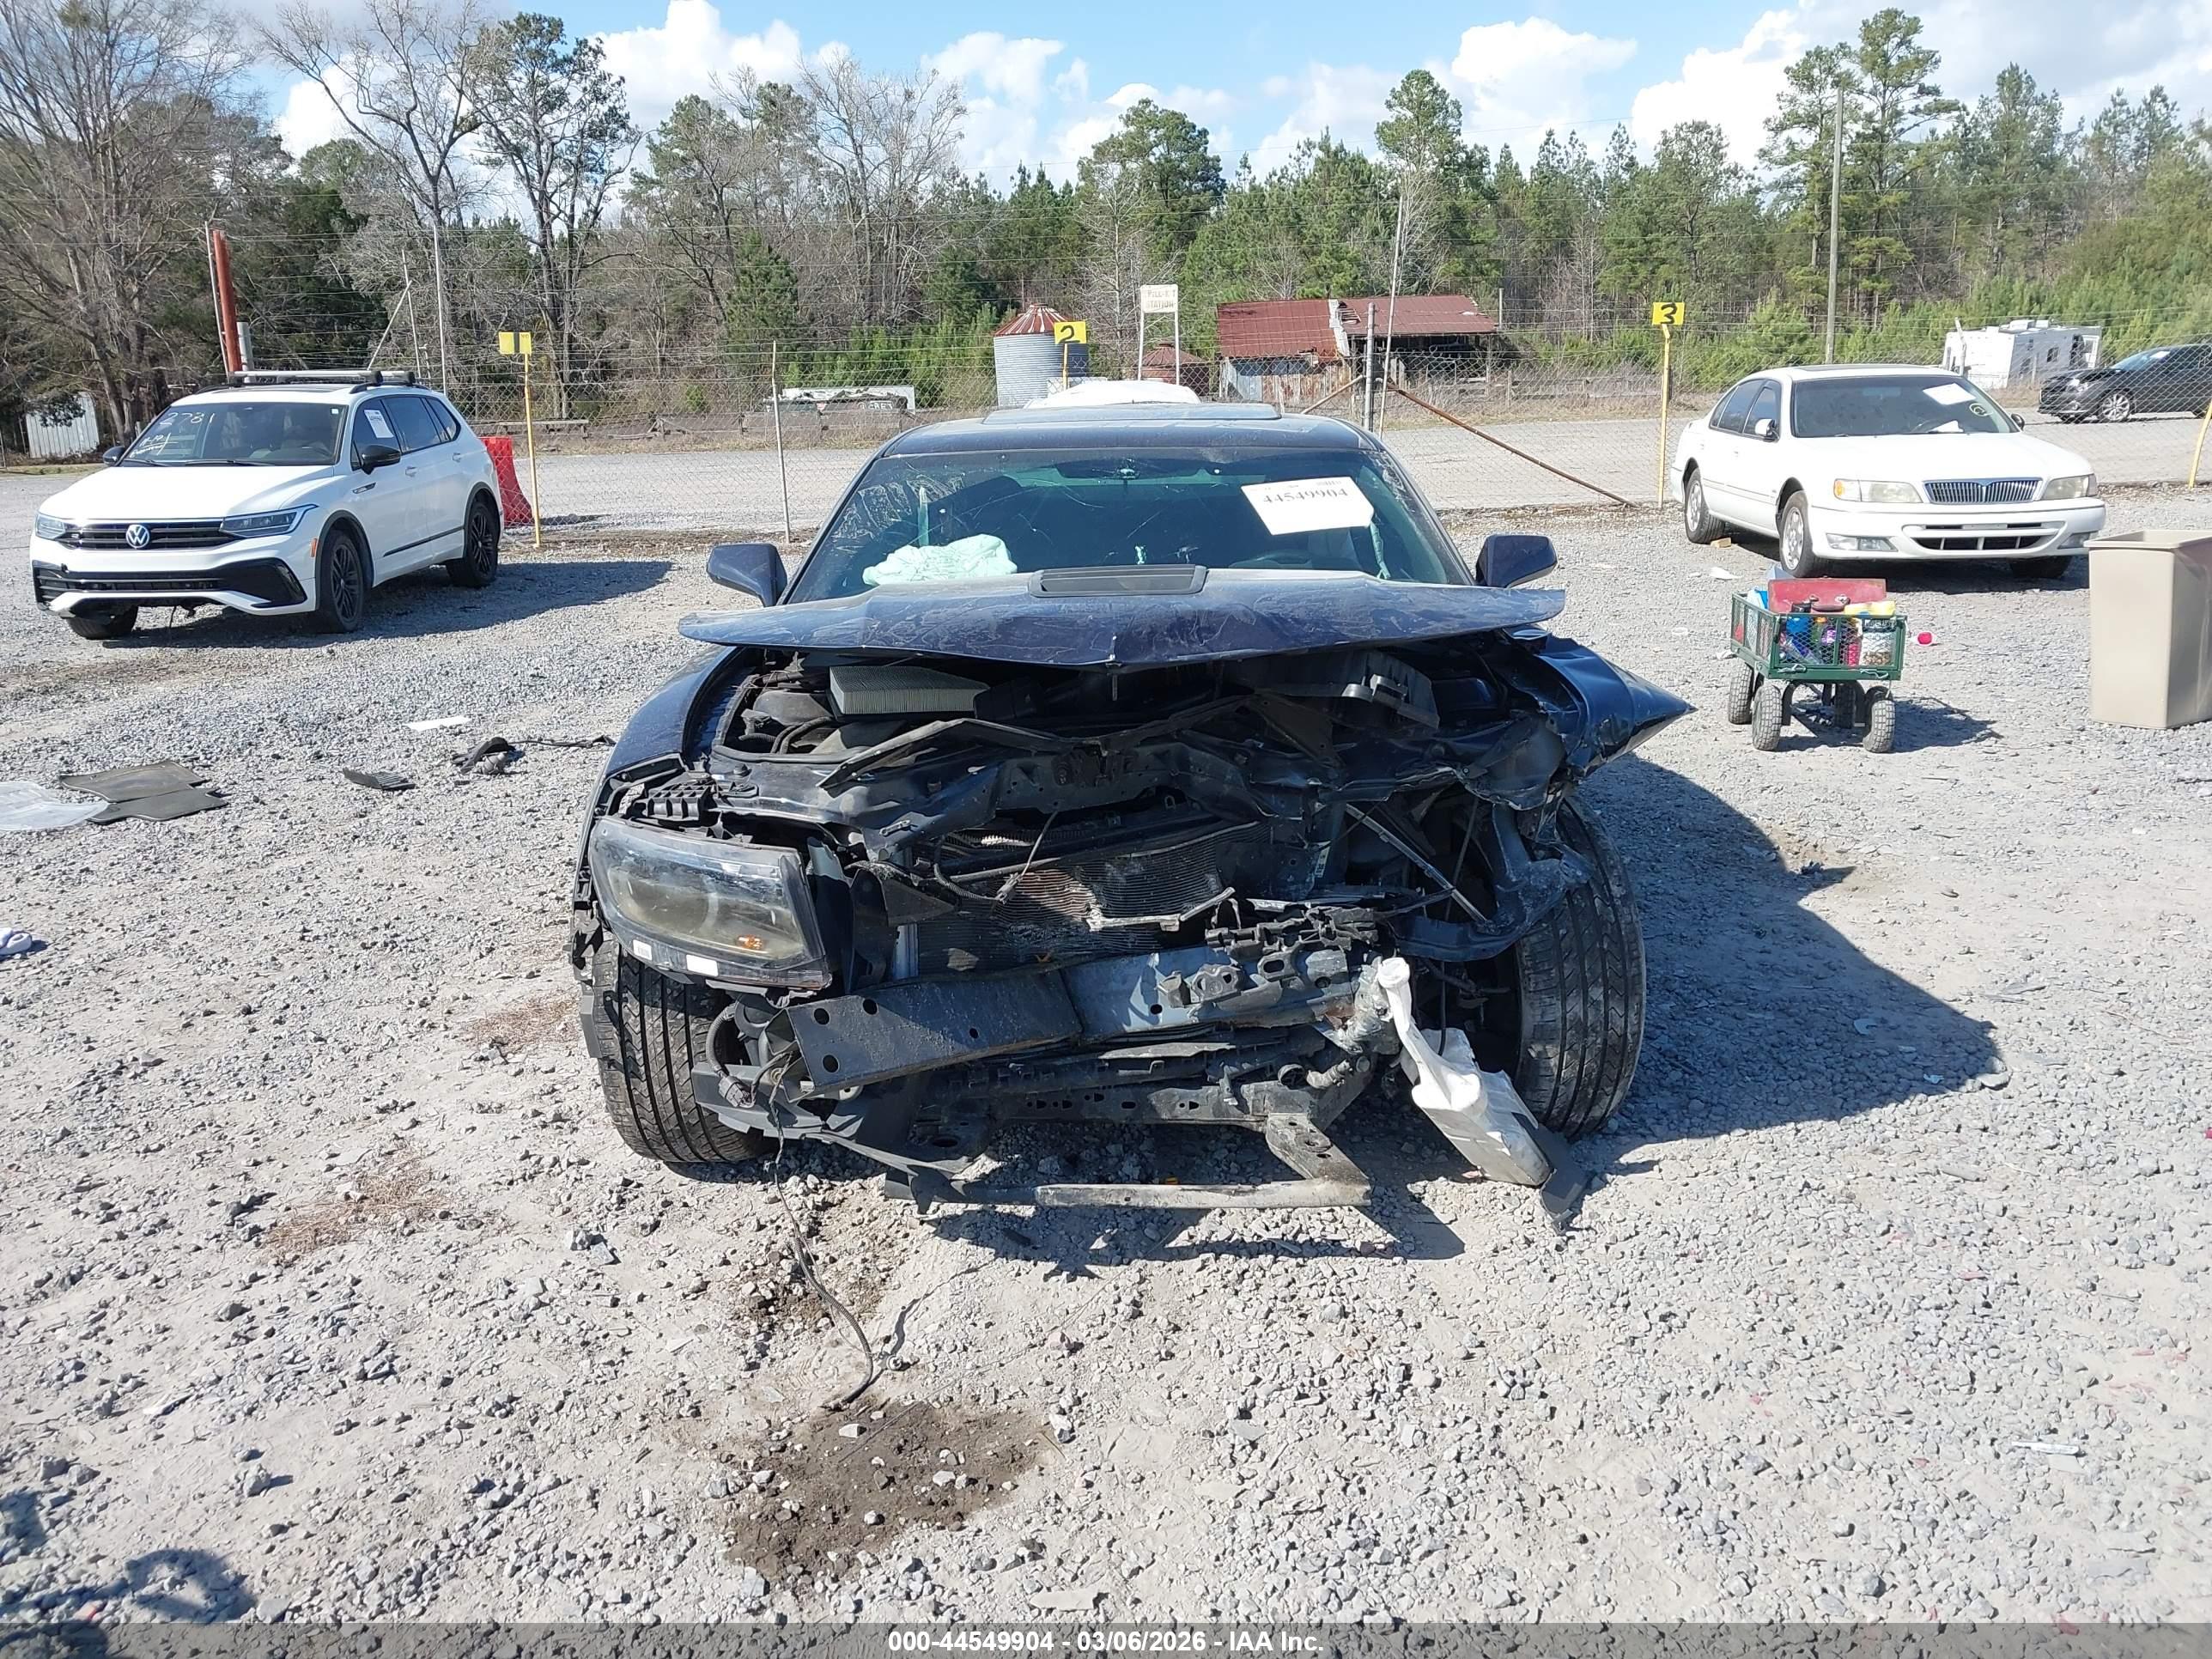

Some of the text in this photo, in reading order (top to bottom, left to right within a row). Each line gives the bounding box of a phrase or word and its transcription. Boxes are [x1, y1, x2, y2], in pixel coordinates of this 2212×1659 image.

[1660, 303, 1678, 324] 3
[1059, 325, 1081, 343] 2
[1263, 488, 1347, 503] 44549904
